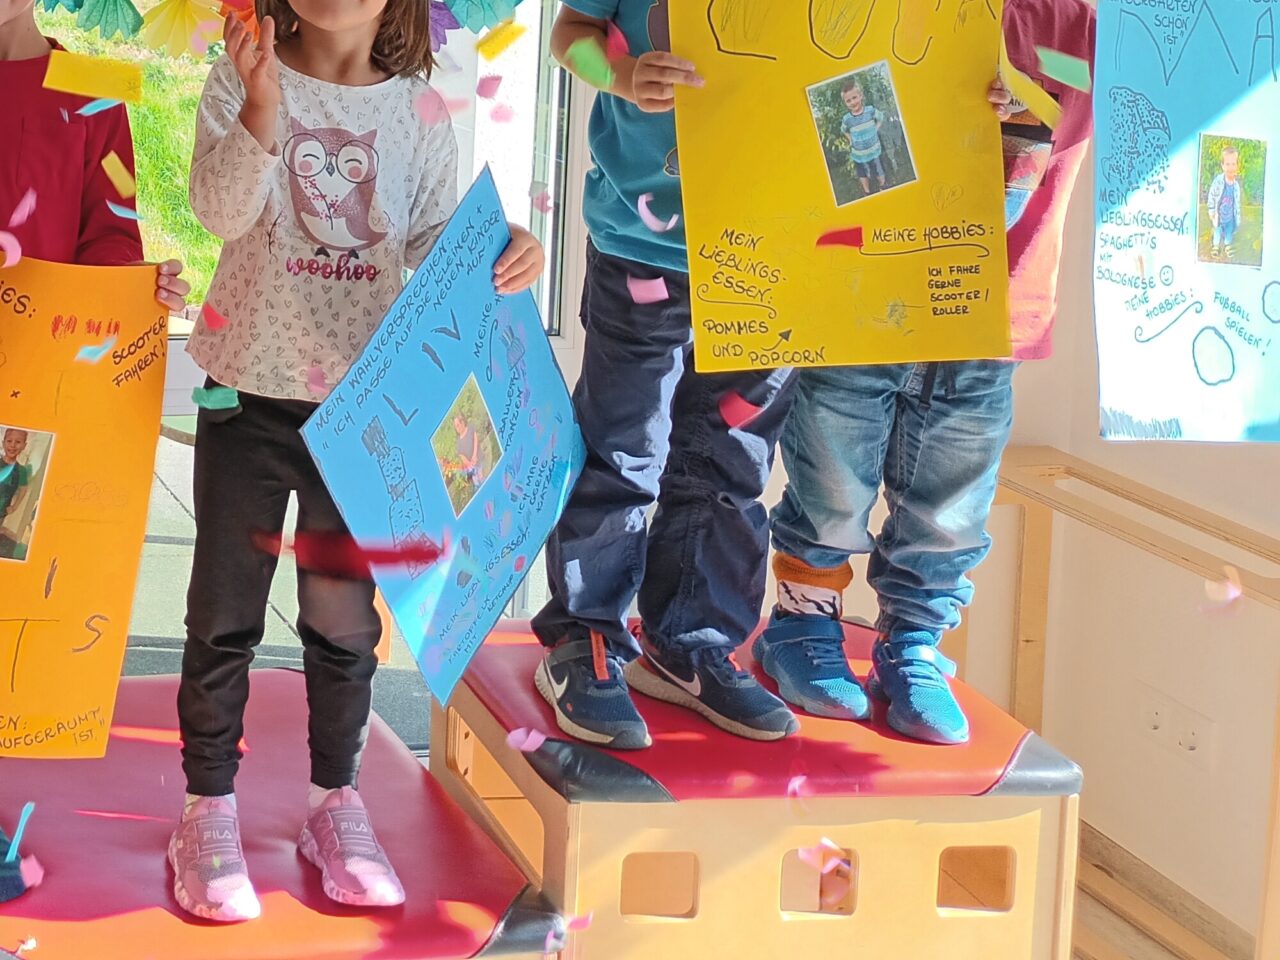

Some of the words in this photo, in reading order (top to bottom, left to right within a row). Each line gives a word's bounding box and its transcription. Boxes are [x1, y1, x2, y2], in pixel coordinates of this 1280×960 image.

[1153, 13, 1191, 36] SCHÖN
[1099, 186, 1129, 207] MEIN
[720, 227, 764, 251] MEIN
[872, 226, 917, 243] MEINE
[923, 220, 995, 251] HOBBIES:
[286, 253, 383, 283] woohoo
[432, 257, 464, 313] NEUEN
[467, 209, 501, 254] KINDER
[928, 266, 943, 277] ICH
[949, 264, 981, 276] FAHRE
[927, 279, 962, 290] GERNE
[355, 356, 393, 409] PASSE
[395, 321, 414, 355] AUF
[416, 292, 433, 324] DIE
[434, 215, 476, 288] KLEINEN
[931, 305, 970, 316] ROLLER
[112, 315, 167, 365] SCOOTER
[315, 391, 346, 432] MEIN
[348, 236, 454, 390] WAHLVERSPRECHEN:
[472, 301, 493, 358] MEINE
[702, 318, 769, 336] POMMES
[711, 342, 745, 357] UND
[748, 345, 826, 366] POPCORN
[503, 387, 525, 453] TANZEN
[517, 492, 530, 515] ICH
[525, 454, 540, 489] MAG
[528, 459, 550, 507] GERNE
[438, 607, 459, 641] MEIN
[464, 633, 479, 655] MIT
[202, 829, 234, 842] FILA
[340, 820, 369, 833] FILA
